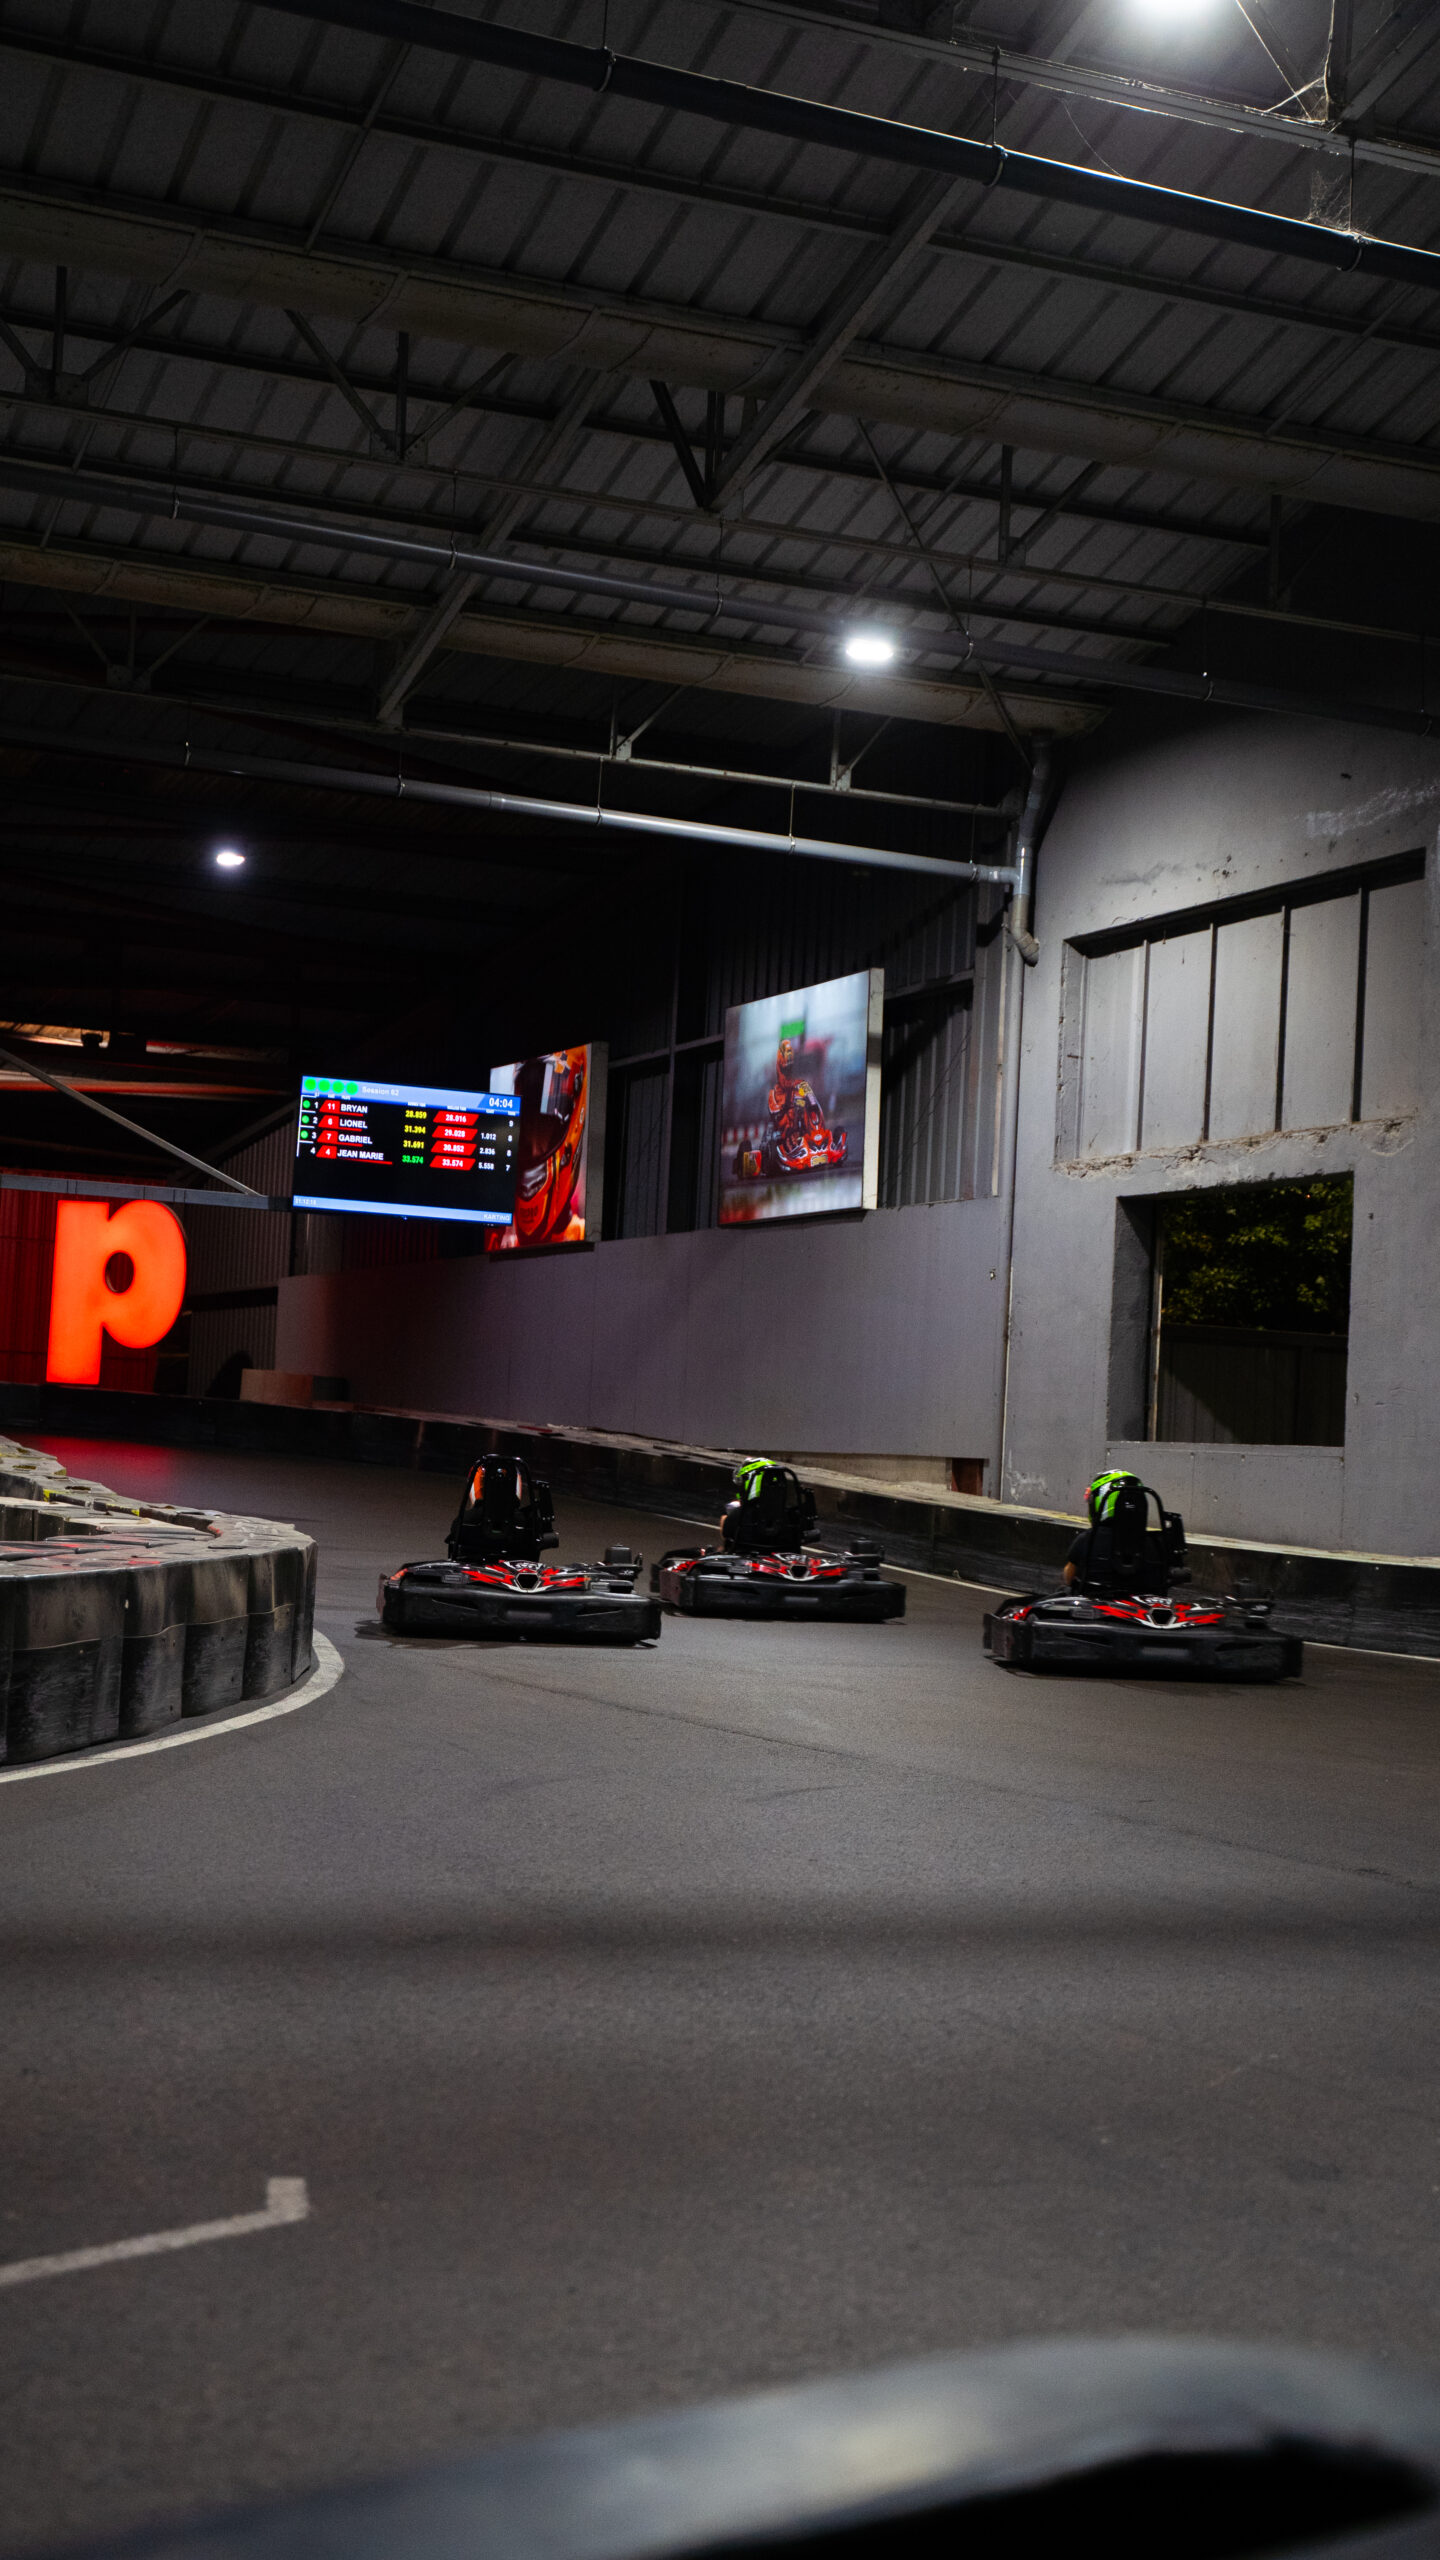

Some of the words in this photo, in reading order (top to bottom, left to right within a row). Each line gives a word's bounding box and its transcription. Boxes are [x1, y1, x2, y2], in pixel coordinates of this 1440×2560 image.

[362, 1086, 389, 1095] Session
[314, 1101, 319, 1109] 1
[327, 1102, 336, 1110] 11
[340, 1104, 368, 1114] BRYAN
[445, 1113, 467, 1123] 28.016
[489, 1097, 513, 1109] 04:04
[312, 1116, 318, 1124] 2
[339, 1118, 368, 1129] LIONEL
[404, 1124, 426, 1135] 31.394
[444, 1128, 466, 1138] 29.028
[481, 1132, 497, 1142] 1.012
[311, 1131, 317, 1139] 3
[338, 1133, 373, 1144] GABRIEL
[443, 1143, 465, 1153] 30.852
[479, 1147, 496, 1156] 2.836
[310, 1147, 316, 1155] 4
[325, 1148, 331, 1156] 4
[337, 1149, 358, 1159] JEAN
[359, 1151, 384, 1160] MARIE
[402, 1154, 424, 1165] 33.574
[442, 1158, 464, 1168] 33.574
[505, 1164, 511, 1172] 7
[483, 1213, 510, 1222] KARTING
